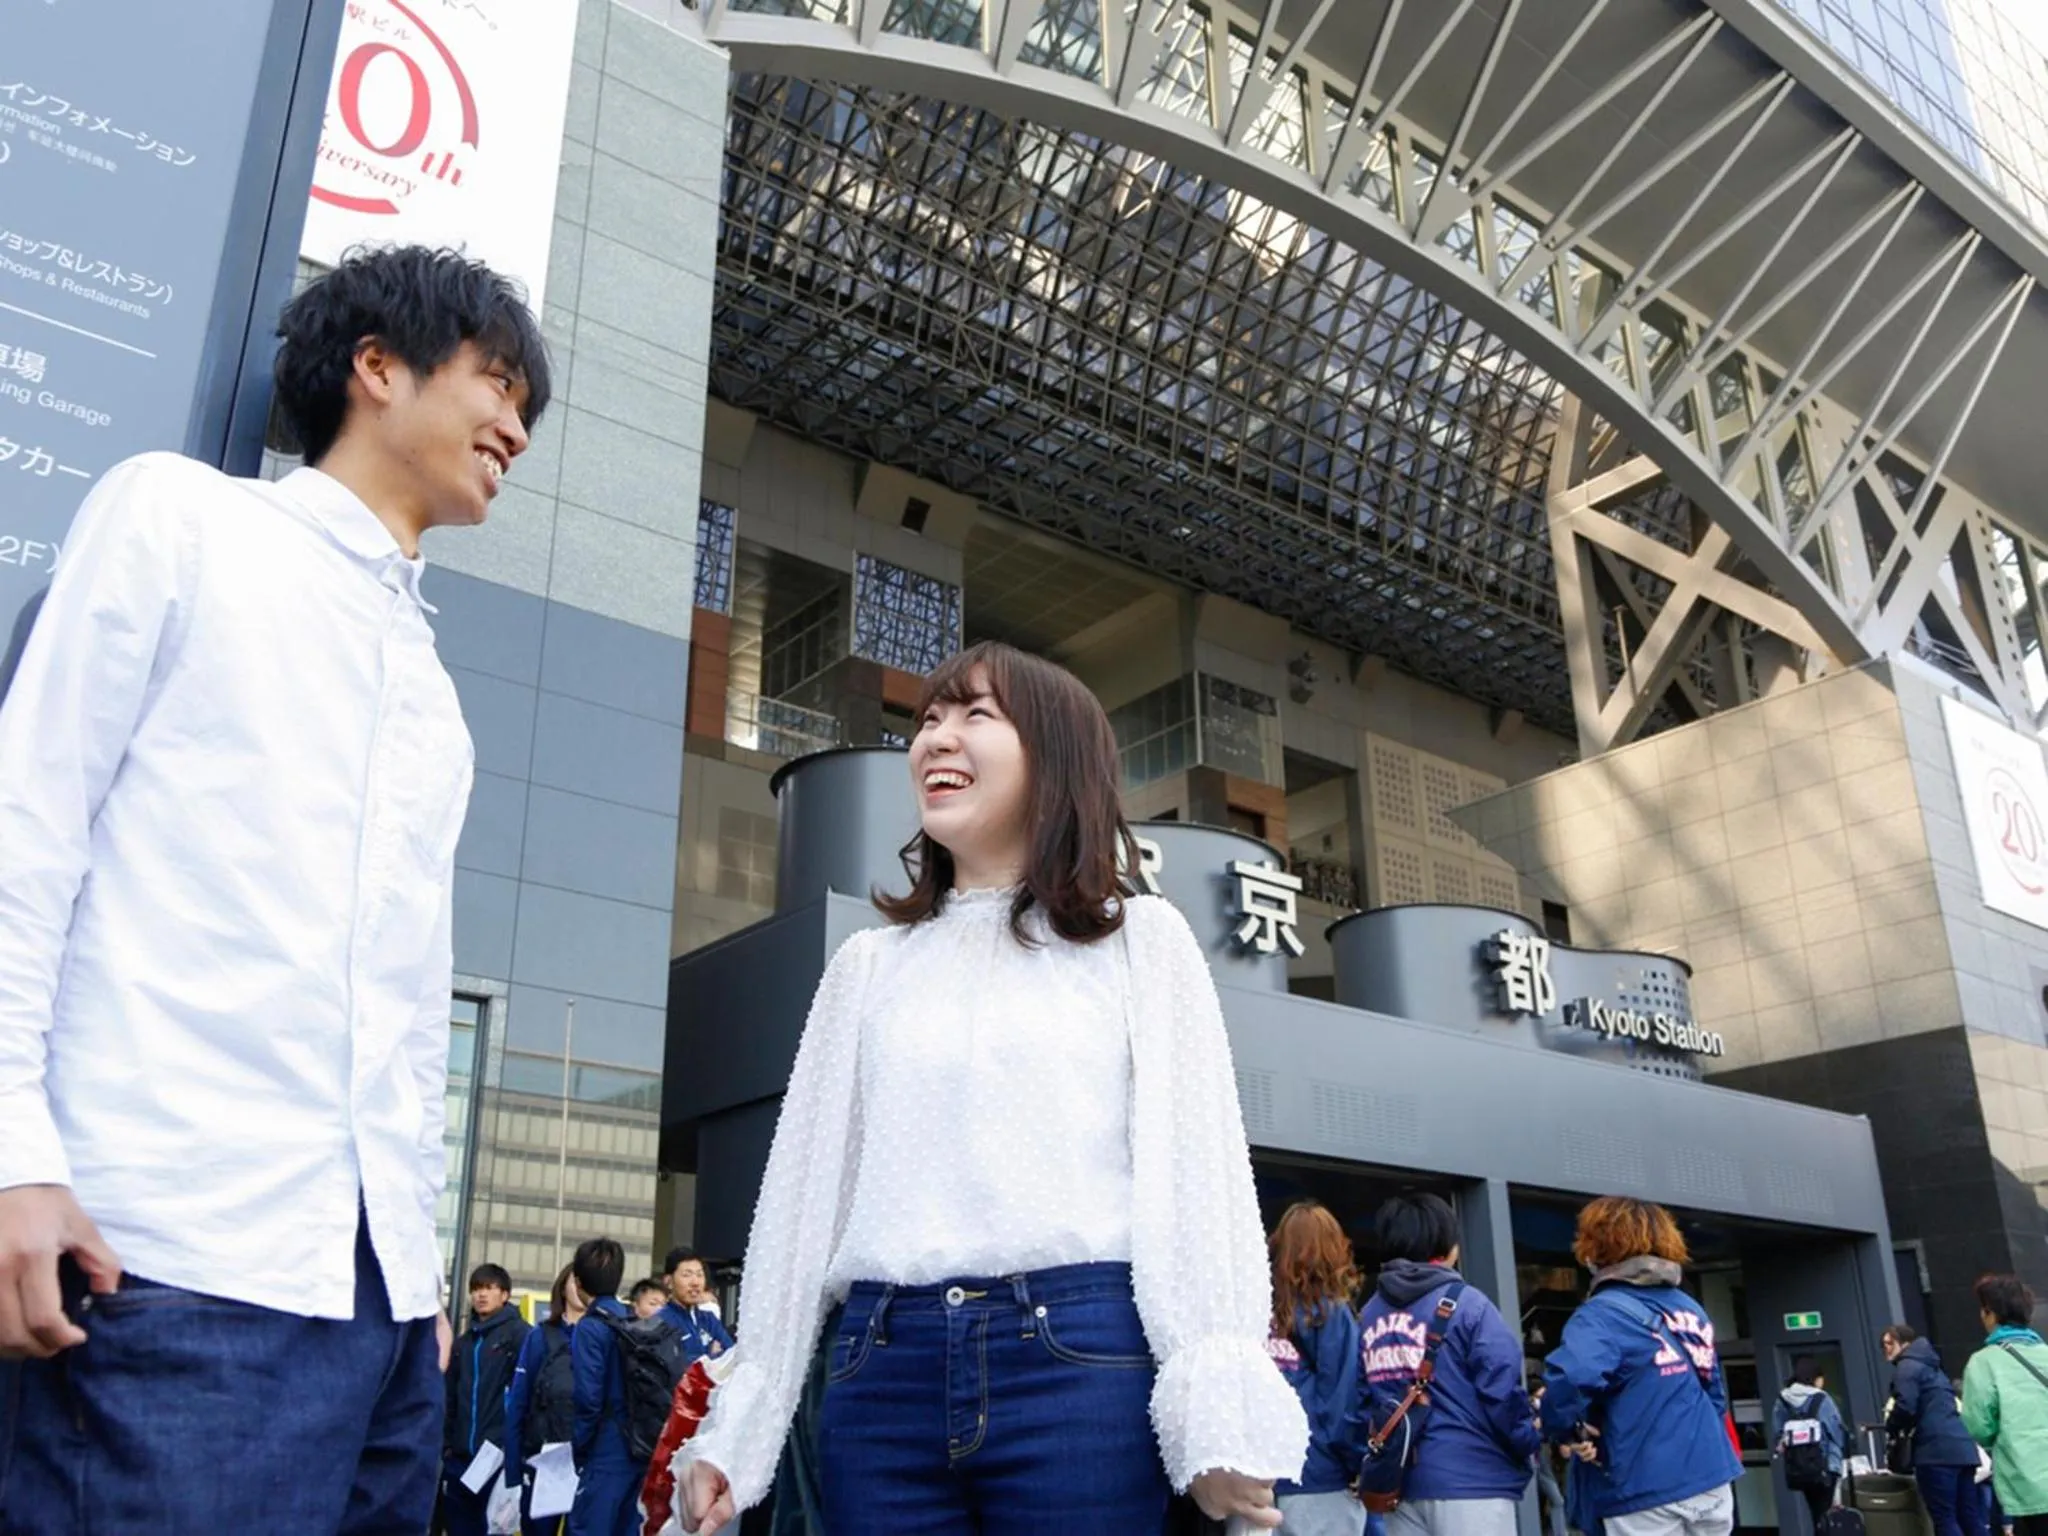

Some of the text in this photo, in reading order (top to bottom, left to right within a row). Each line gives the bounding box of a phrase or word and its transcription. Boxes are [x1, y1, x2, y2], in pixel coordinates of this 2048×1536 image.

[0, 81, 197, 166] インフォメーション
[37, 390, 112, 427] Garage
[1588, 996, 1650, 1041] Kyoto
[1653, 1011, 1725, 1056] Station
